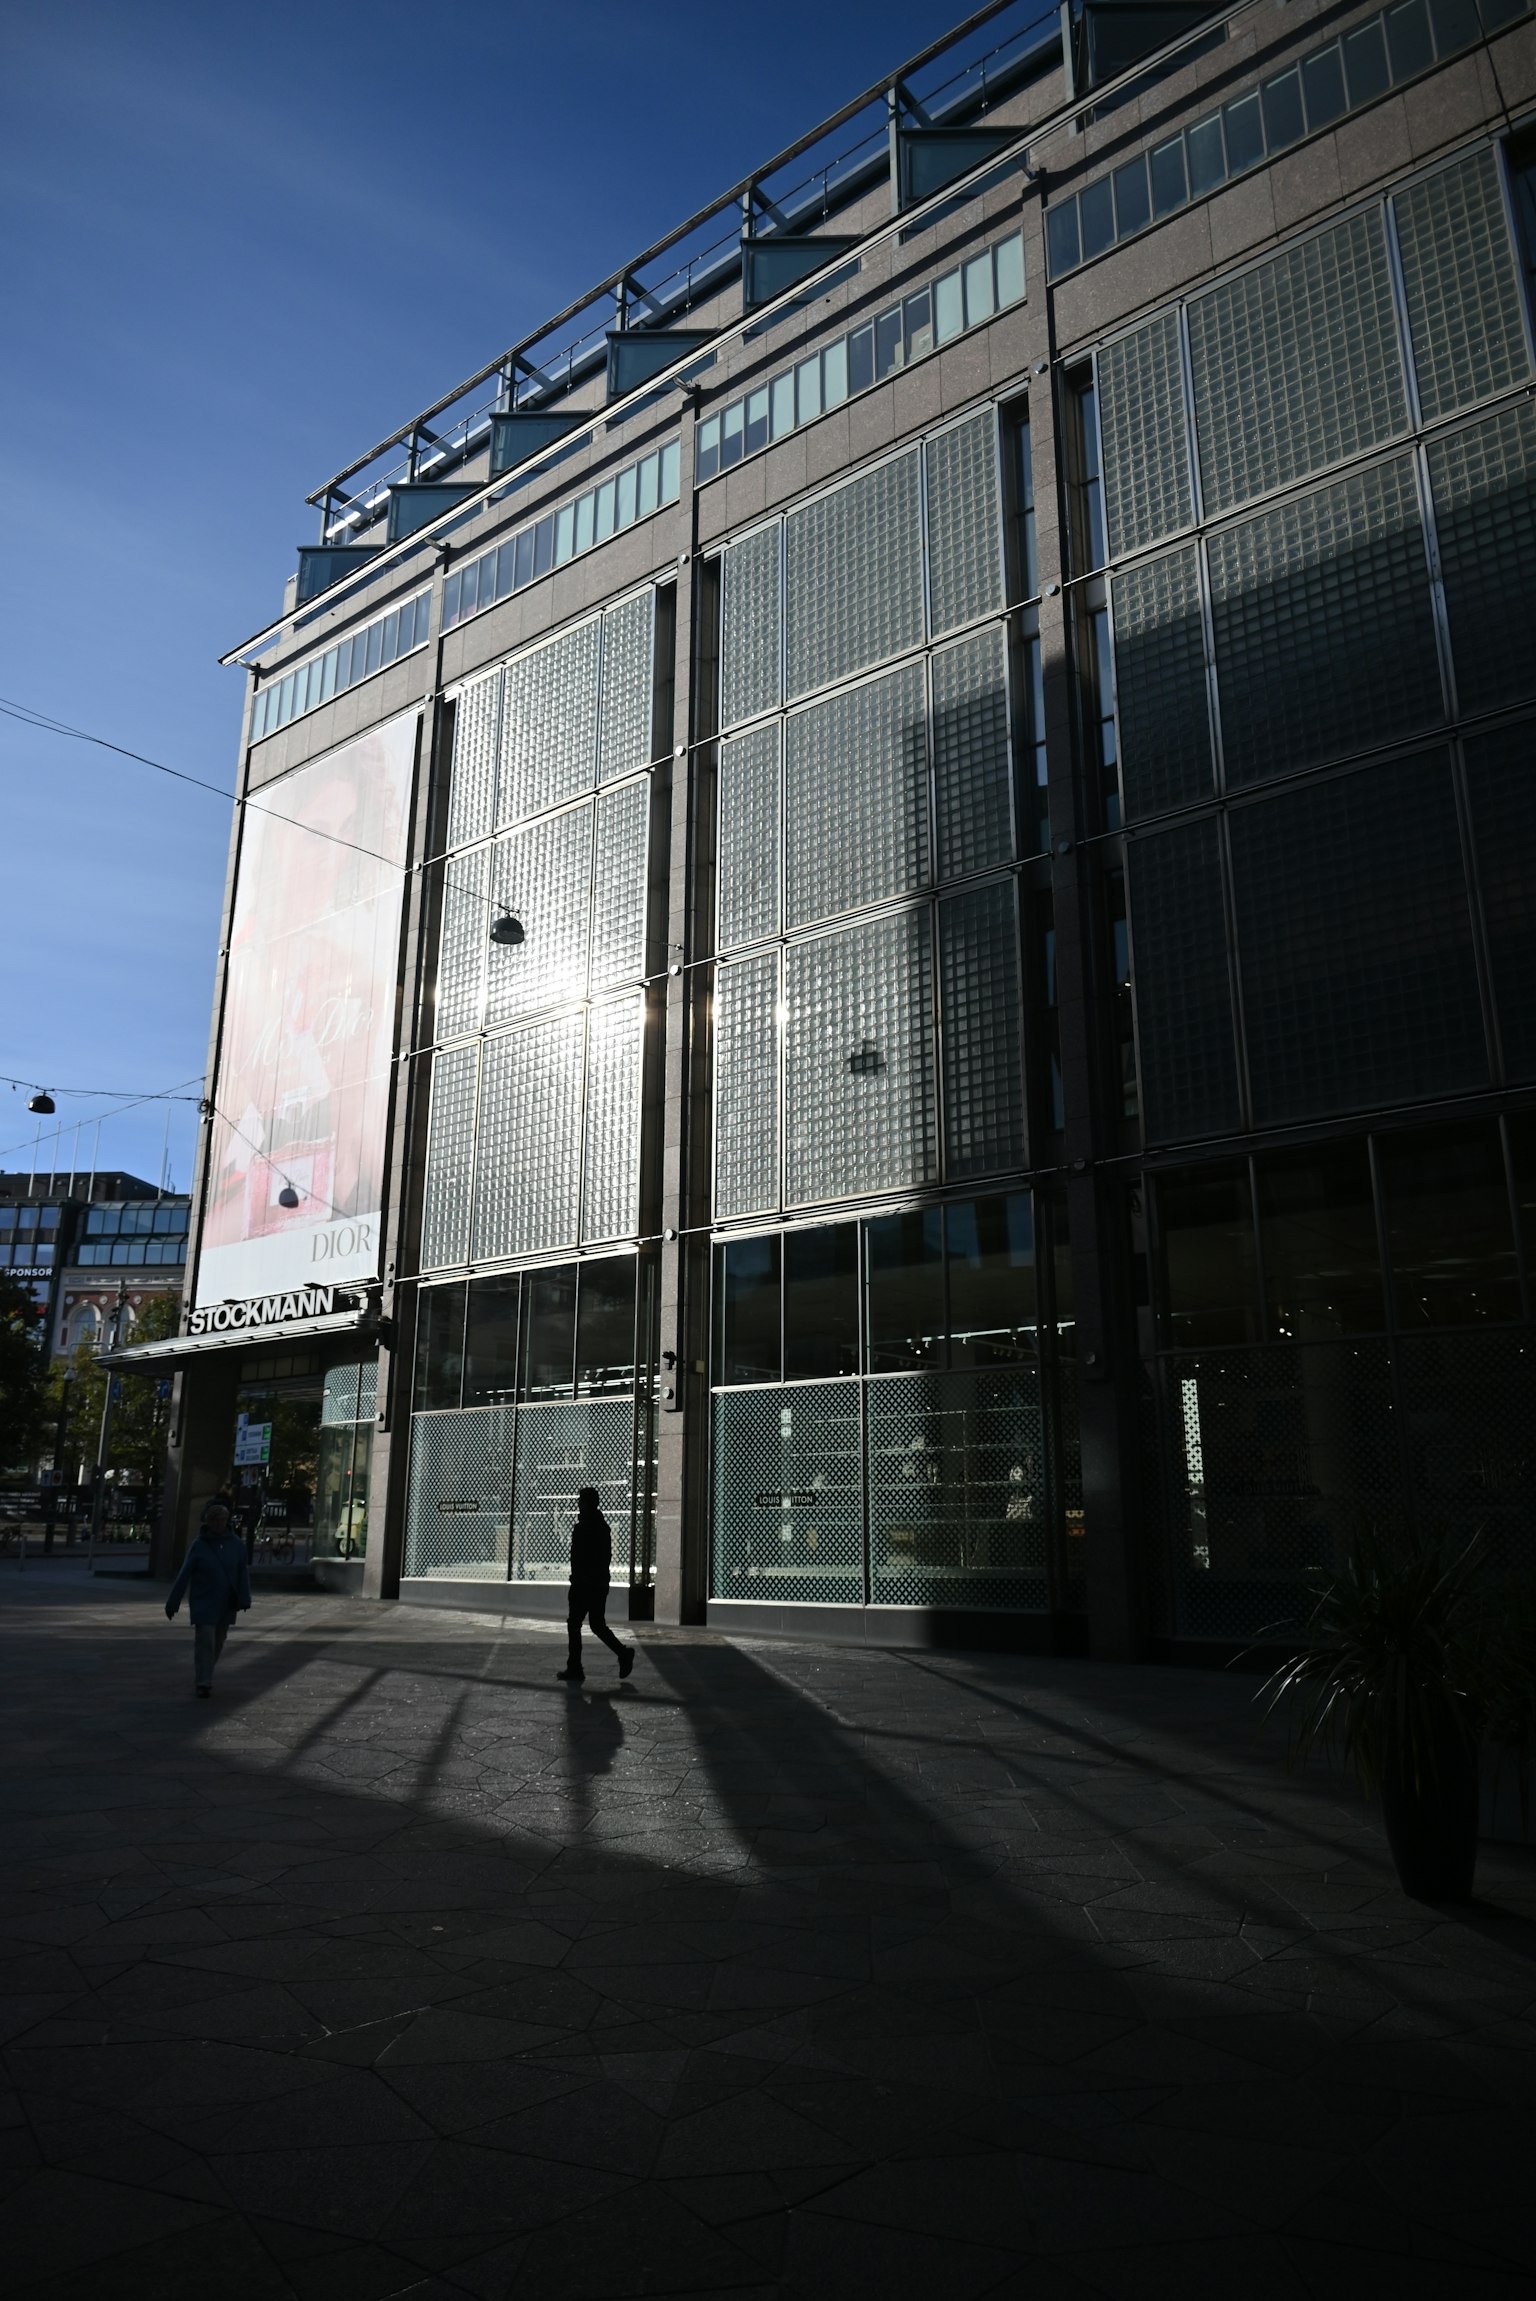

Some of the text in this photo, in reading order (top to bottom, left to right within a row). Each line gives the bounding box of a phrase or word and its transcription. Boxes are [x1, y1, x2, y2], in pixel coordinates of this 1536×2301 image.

[310, 1223, 372, 1263] DIOR
[189, 1287, 335, 1335] STOCKMANN
[759, 1496, 780, 1504] LOUIS
